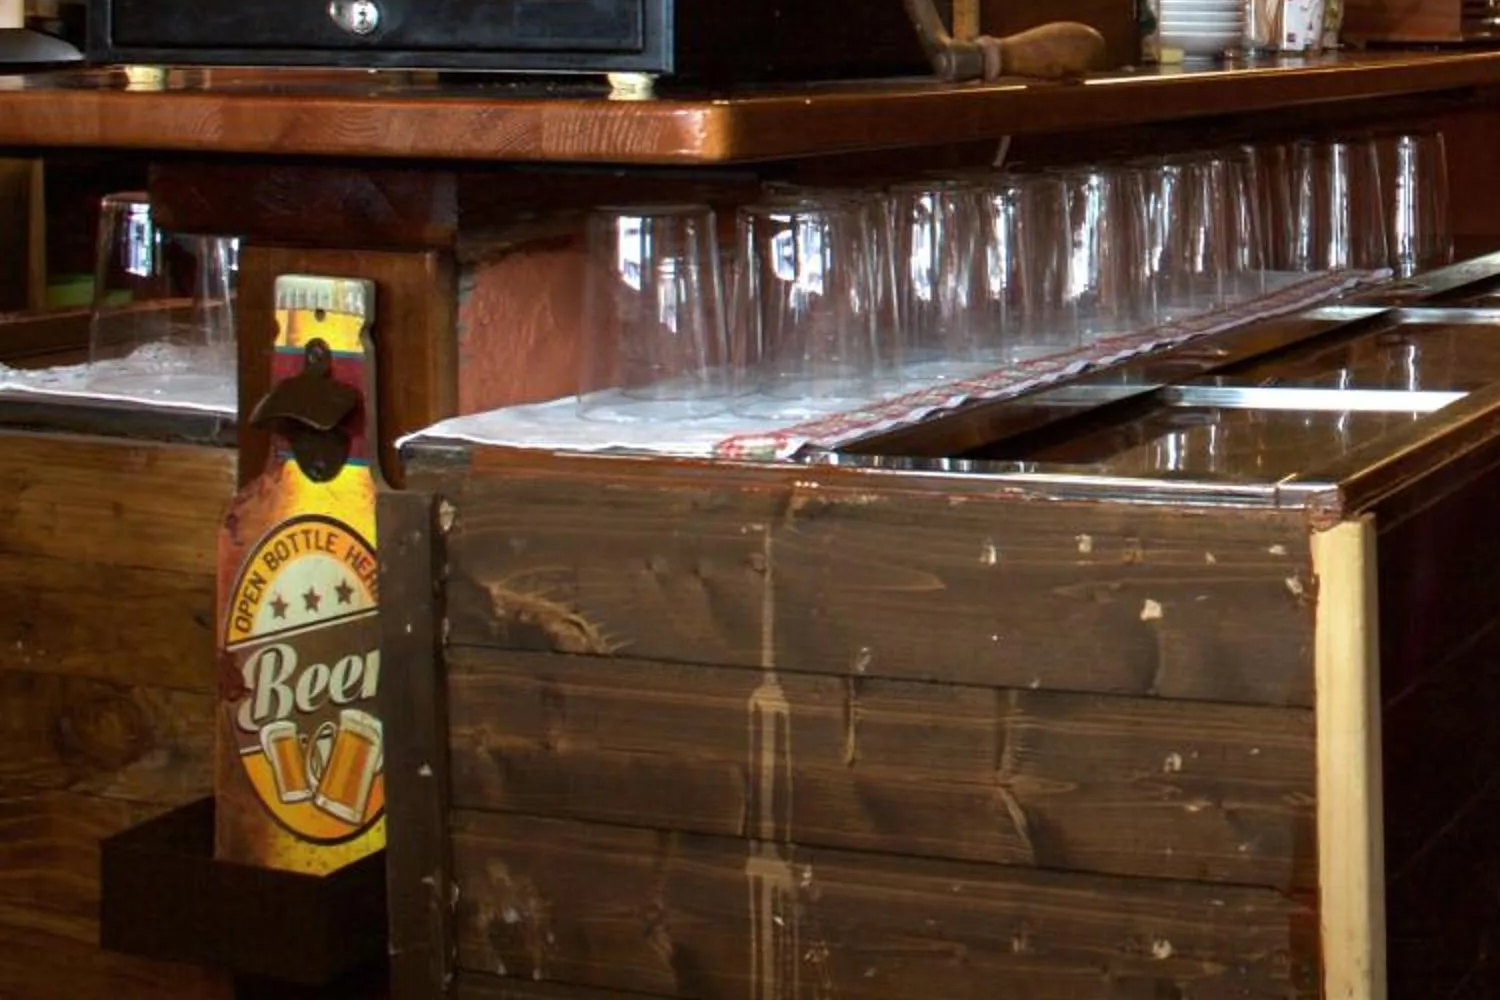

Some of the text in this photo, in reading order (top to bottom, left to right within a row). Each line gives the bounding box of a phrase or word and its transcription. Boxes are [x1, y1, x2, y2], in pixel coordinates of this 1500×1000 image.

[234, 528, 379, 634] OPEN BOTTLE HER
[237, 643, 381, 731] Beer
